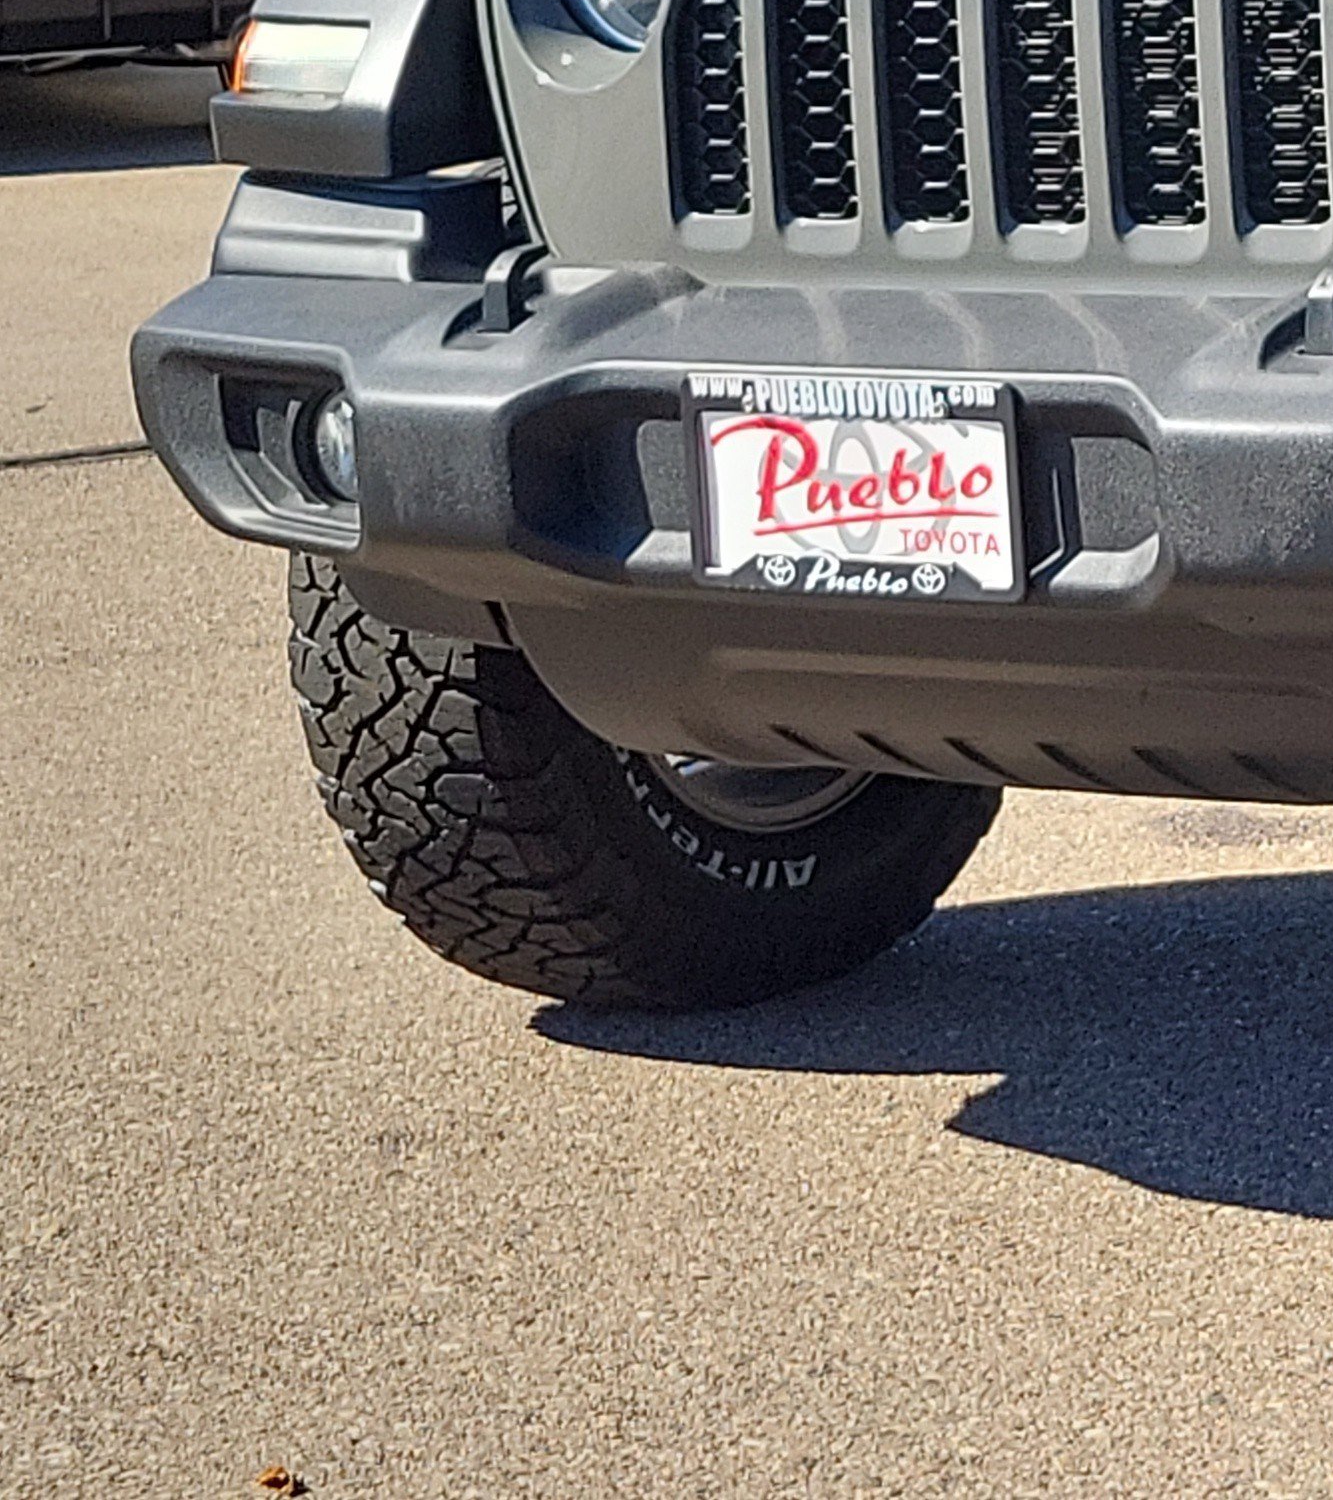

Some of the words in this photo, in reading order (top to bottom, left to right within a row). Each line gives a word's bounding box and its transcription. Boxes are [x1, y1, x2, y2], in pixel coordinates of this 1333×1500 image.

[710, 415, 993, 522] Pueblo
[899, 528, 1000, 556] TOYOTA
[800, 549, 908, 594] Pueblo
